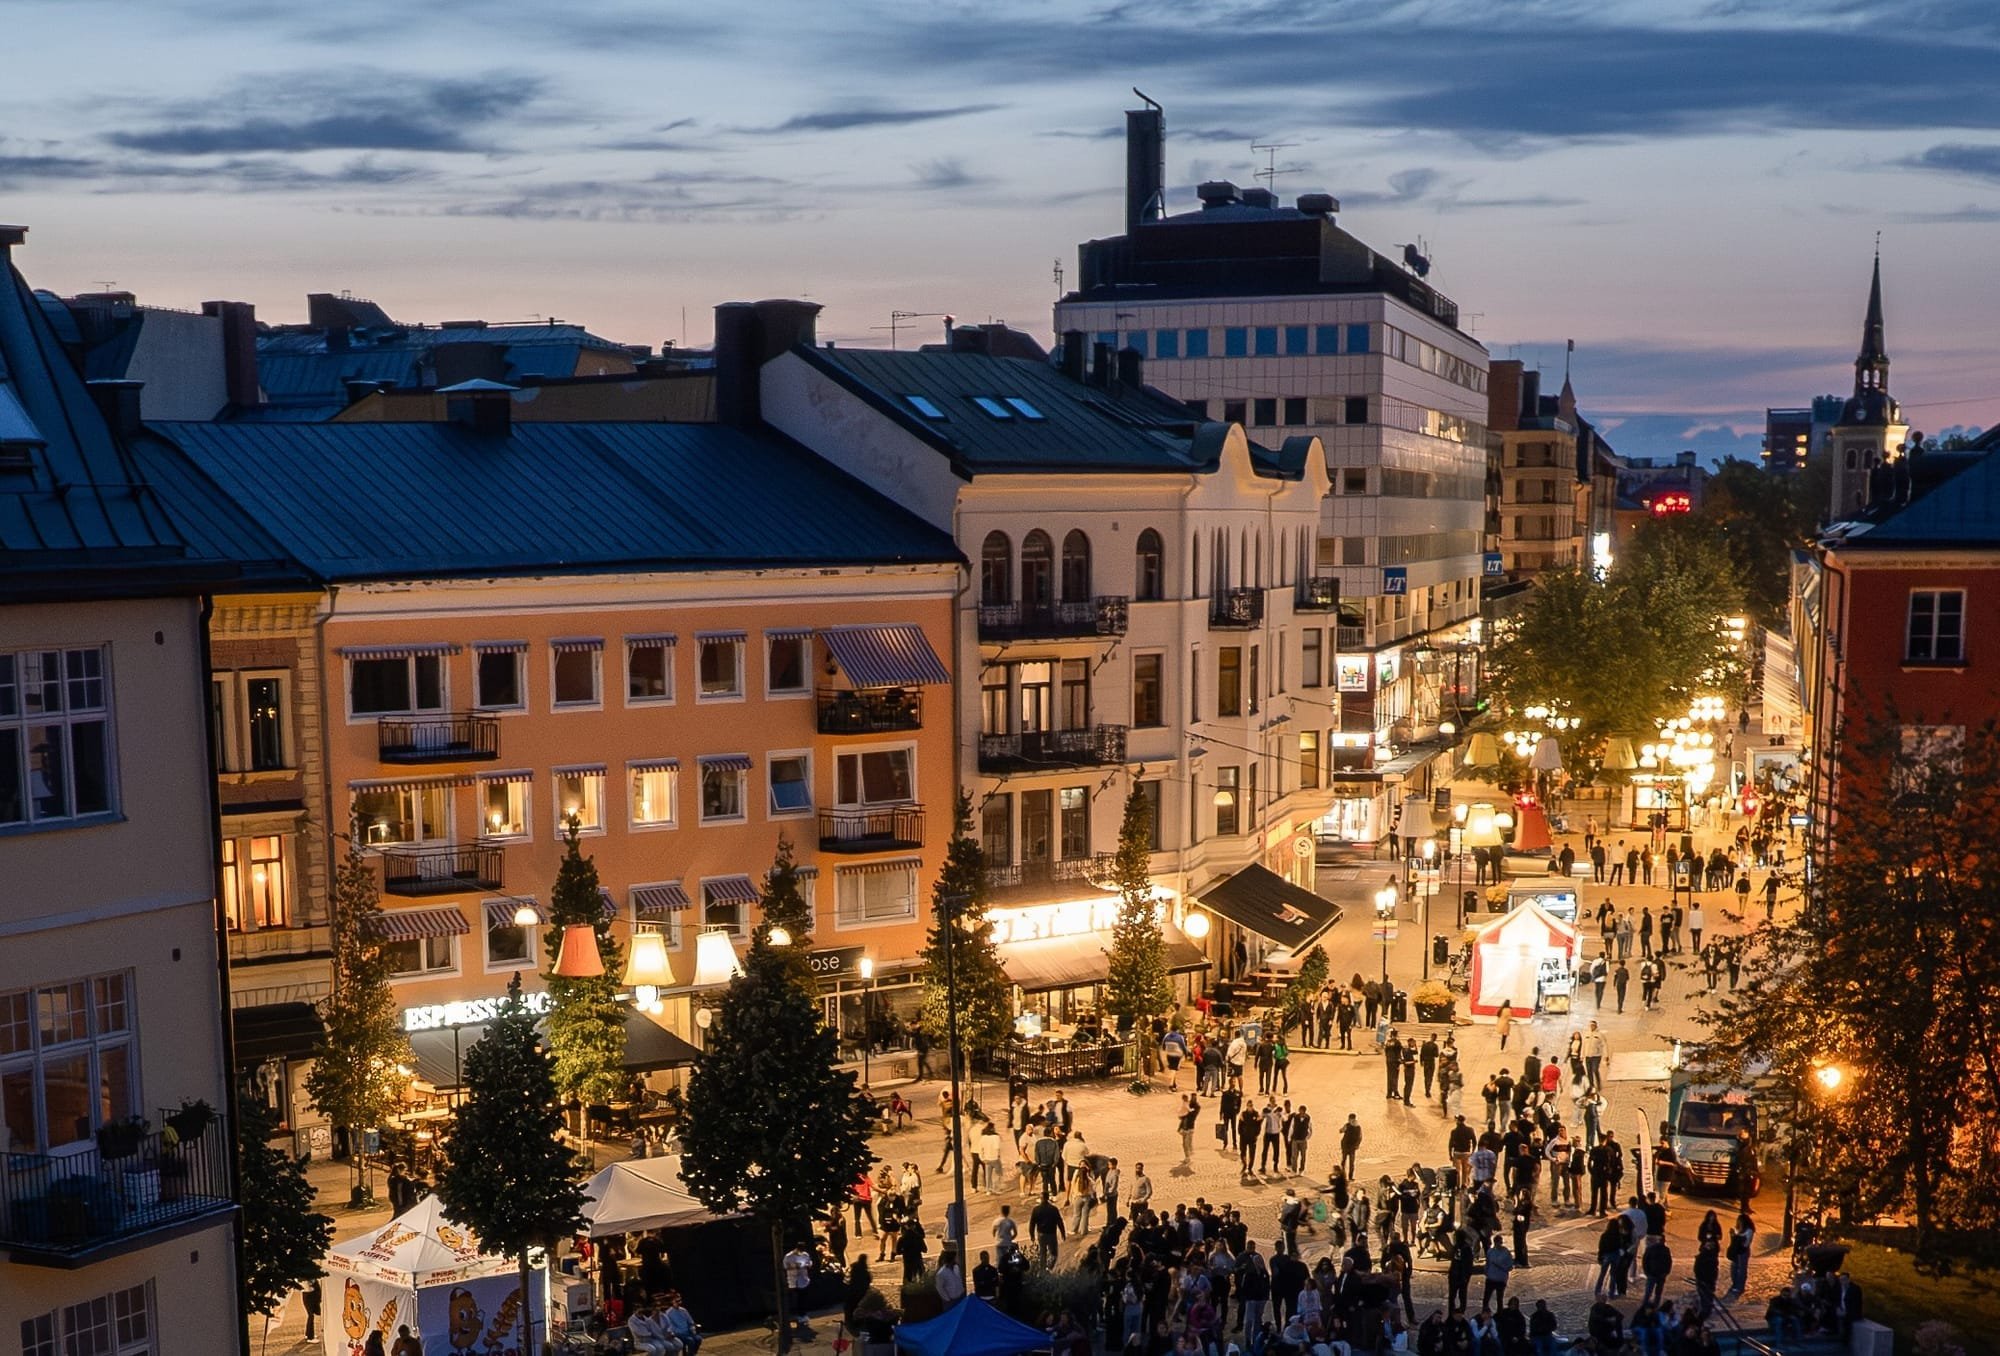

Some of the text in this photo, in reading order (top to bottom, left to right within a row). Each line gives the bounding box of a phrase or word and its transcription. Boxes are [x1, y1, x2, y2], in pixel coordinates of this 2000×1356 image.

[1486, 560, 1503, 572] LT
[1385, 577, 1406, 592] LT
[358, 1250, 391, 1262] POTATO
[424, 1276, 457, 1286] POTATO
